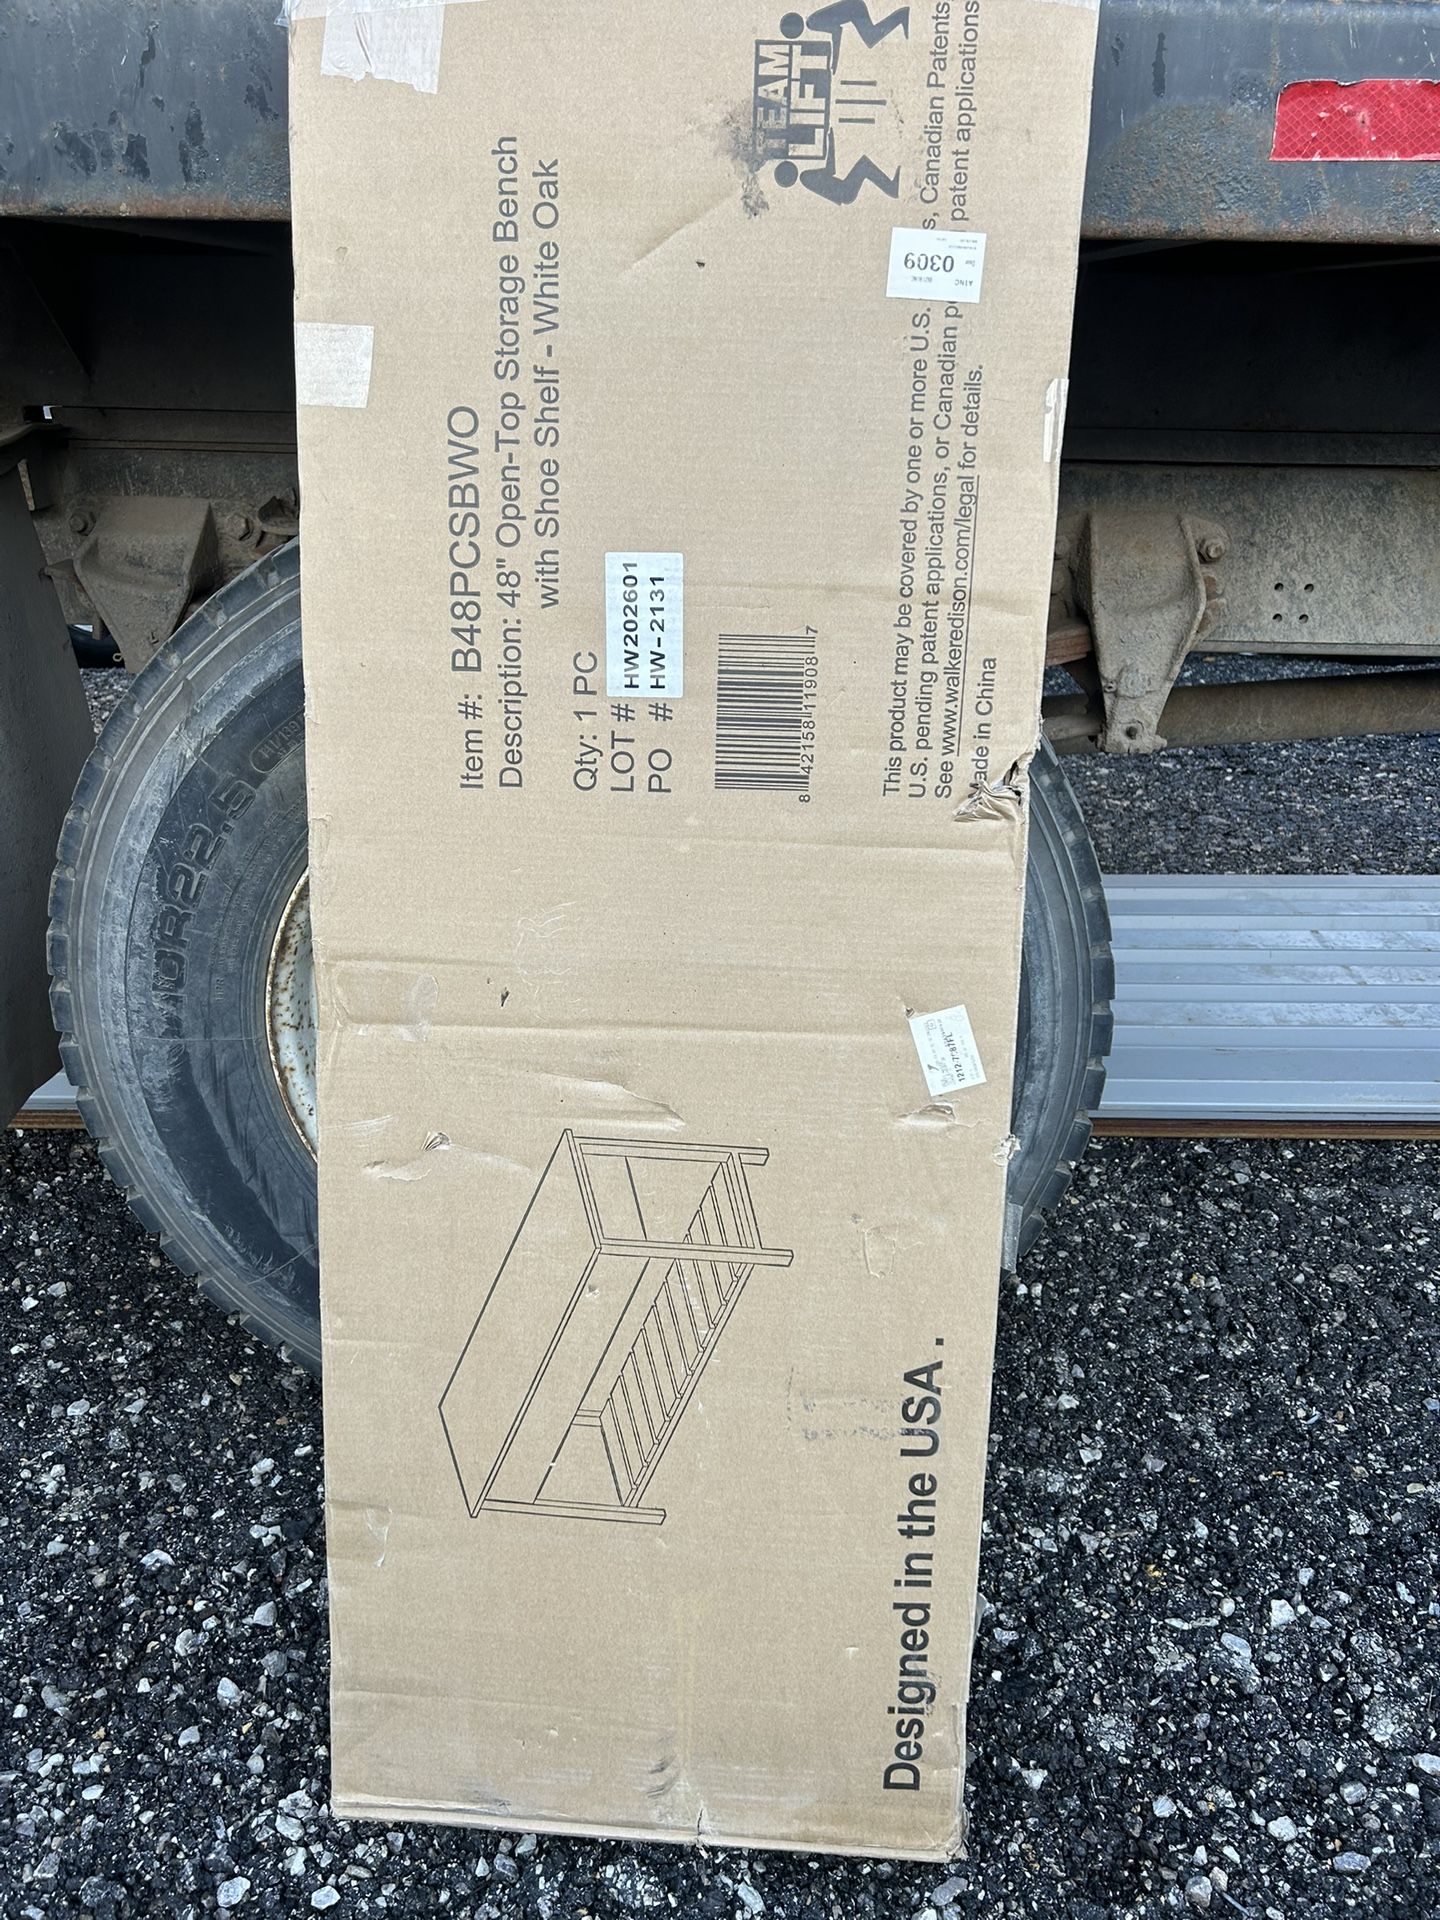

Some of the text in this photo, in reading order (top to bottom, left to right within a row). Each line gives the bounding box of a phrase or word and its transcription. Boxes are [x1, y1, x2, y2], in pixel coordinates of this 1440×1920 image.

[926, 1, 950, 88] Patents
[955, 0, 980, 142] applications
[756, 43, 790, 155] TEAM
[787, 43, 828, 157] LIFT
[919, 96, 945, 205] Canadian
[948, 148, 970, 222] patent
[904, 252, 955, 273] 0309
[531, 158, 560, 610] with Shoe Shelf - White Oak
[933, 326, 958, 430] Canadian
[491, 136, 529, 788] Description: 48" Open-Top Storage Bench
[936, 437, 950, 459] or
[882, 307, 931, 797] This product may be covered by one or more U.S.
[925, 466, 952, 596] applications,
[934, 365, 983, 799] See www.walkeredison.com/legal for details.
[446, 405, 484, 789] Item #: B48PCSBWO
[622, 562, 640, 689] HW202601
[648, 576, 666, 690] HW-2131
[920, 600, 940, 664] patent
[572, 651, 604, 792] Qty: 1 PC
[798, 624, 819, 804] 8 42158 11908 7
[915, 670, 938, 750] pending
[973, 722, 992, 740] in
[975, 657, 997, 716] China
[610, 702, 636, 793] LOT #
[647, 702, 674, 794] PO #
[908, 756, 928, 798] U.S.
[900, 1360, 944, 1458] USA
[898, 1472, 938, 1540] the
[894, 1552, 933, 1588] in
[882, 1601, 936, 1791] Designed
